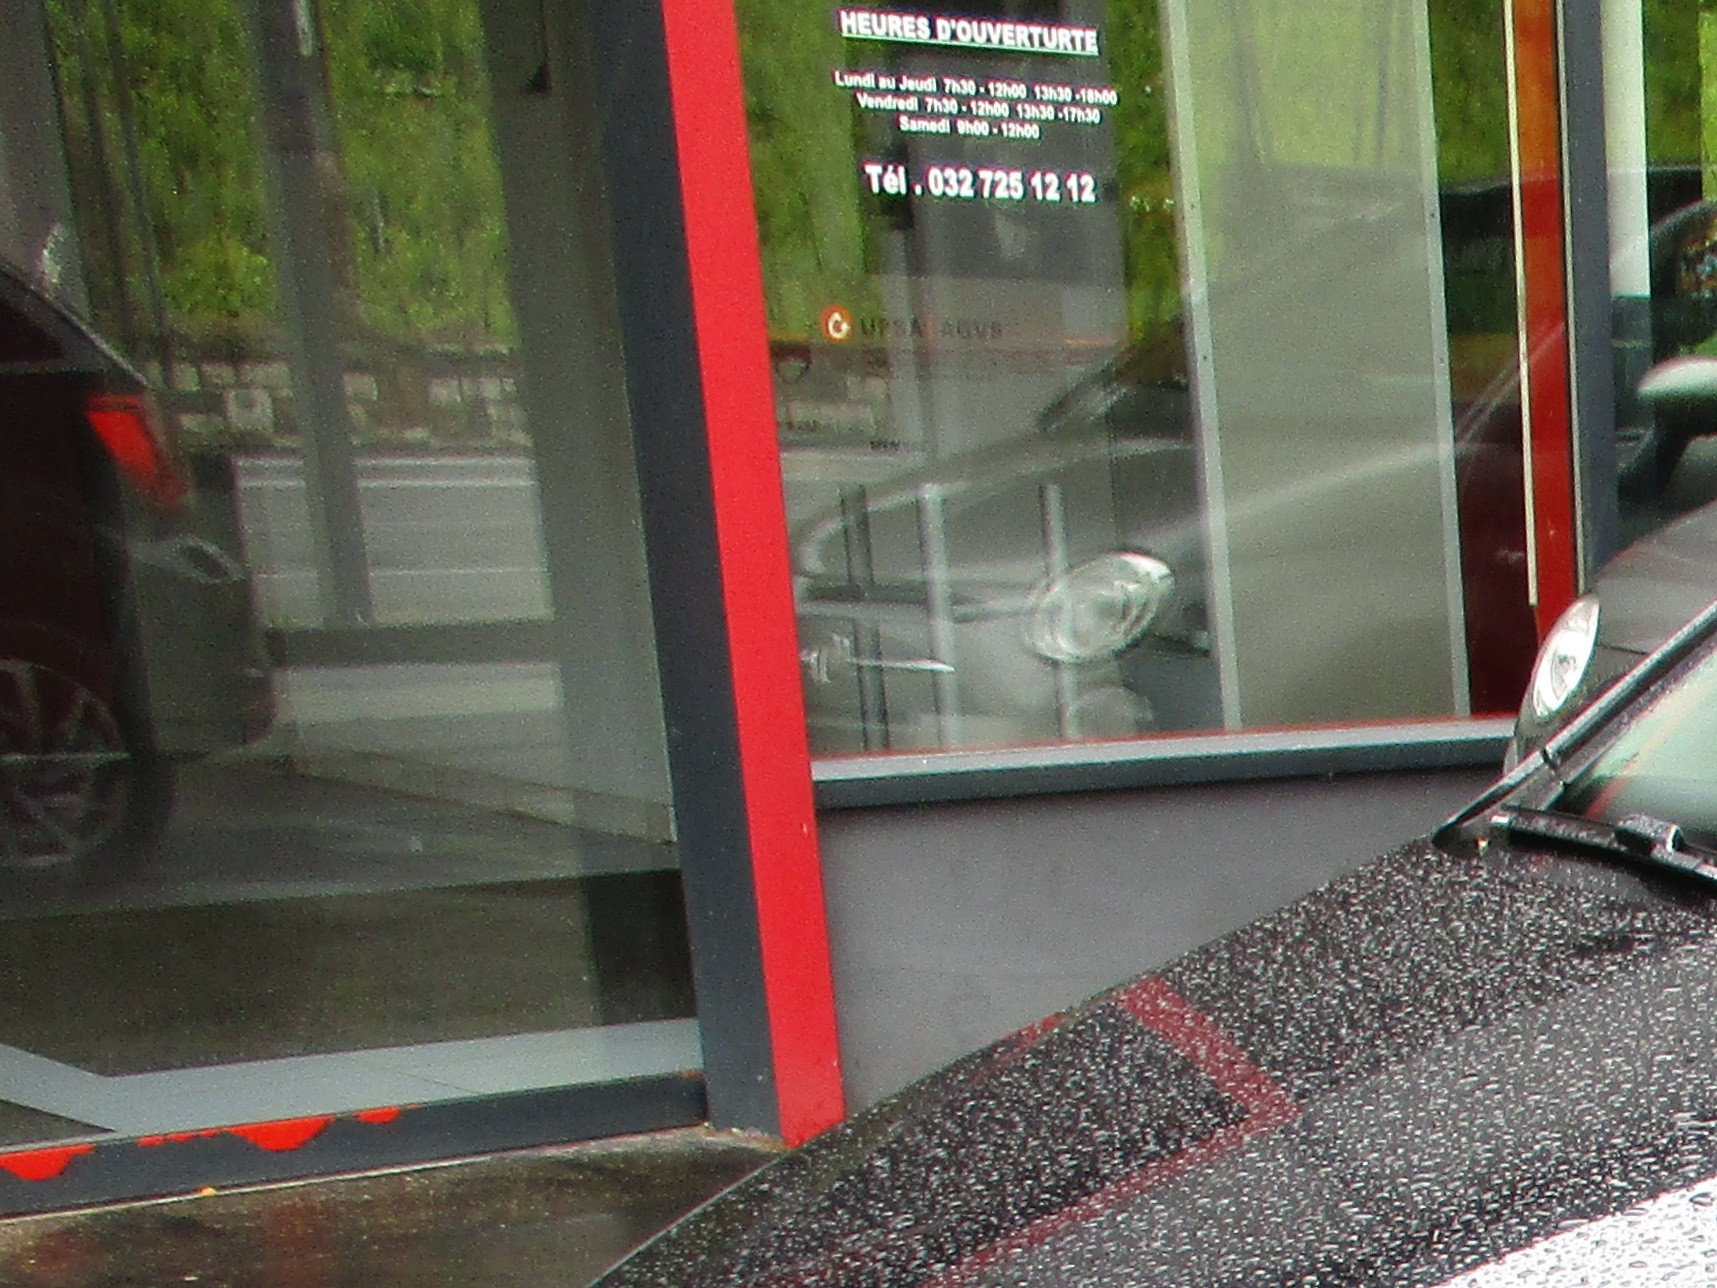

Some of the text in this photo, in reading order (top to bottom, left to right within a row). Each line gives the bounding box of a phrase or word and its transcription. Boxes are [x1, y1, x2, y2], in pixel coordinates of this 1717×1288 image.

[839, 9, 1099, 55] HEURES D'OUVERTURTE
[833, 69, 876, 89] Lundi
[878, 77, 896, 91] au
[899, 75, 937, 93] Jeudi
[943, 78, 977, 97] 7h30
[987, 81, 1028, 101] 12h00
[1033, 84, 1073, 103] 13h30
[855, 92, 919, 111] Vendredi
[923, 96, 959, 115] 7h30
[969, 99, 1010, 118] 12h00
[1016, 102, 1055, 121] 13h30
[899, 115, 951, 134] Samedi
[956, 119, 990, 137] 9h00
[1000, 121, 1041, 140] 12h00
[927, 165, 975, 198] 032
[978, 169, 1024, 200] 725
[1029, 170, 1061, 201] 12
[1065, 171, 1097, 203] 12
